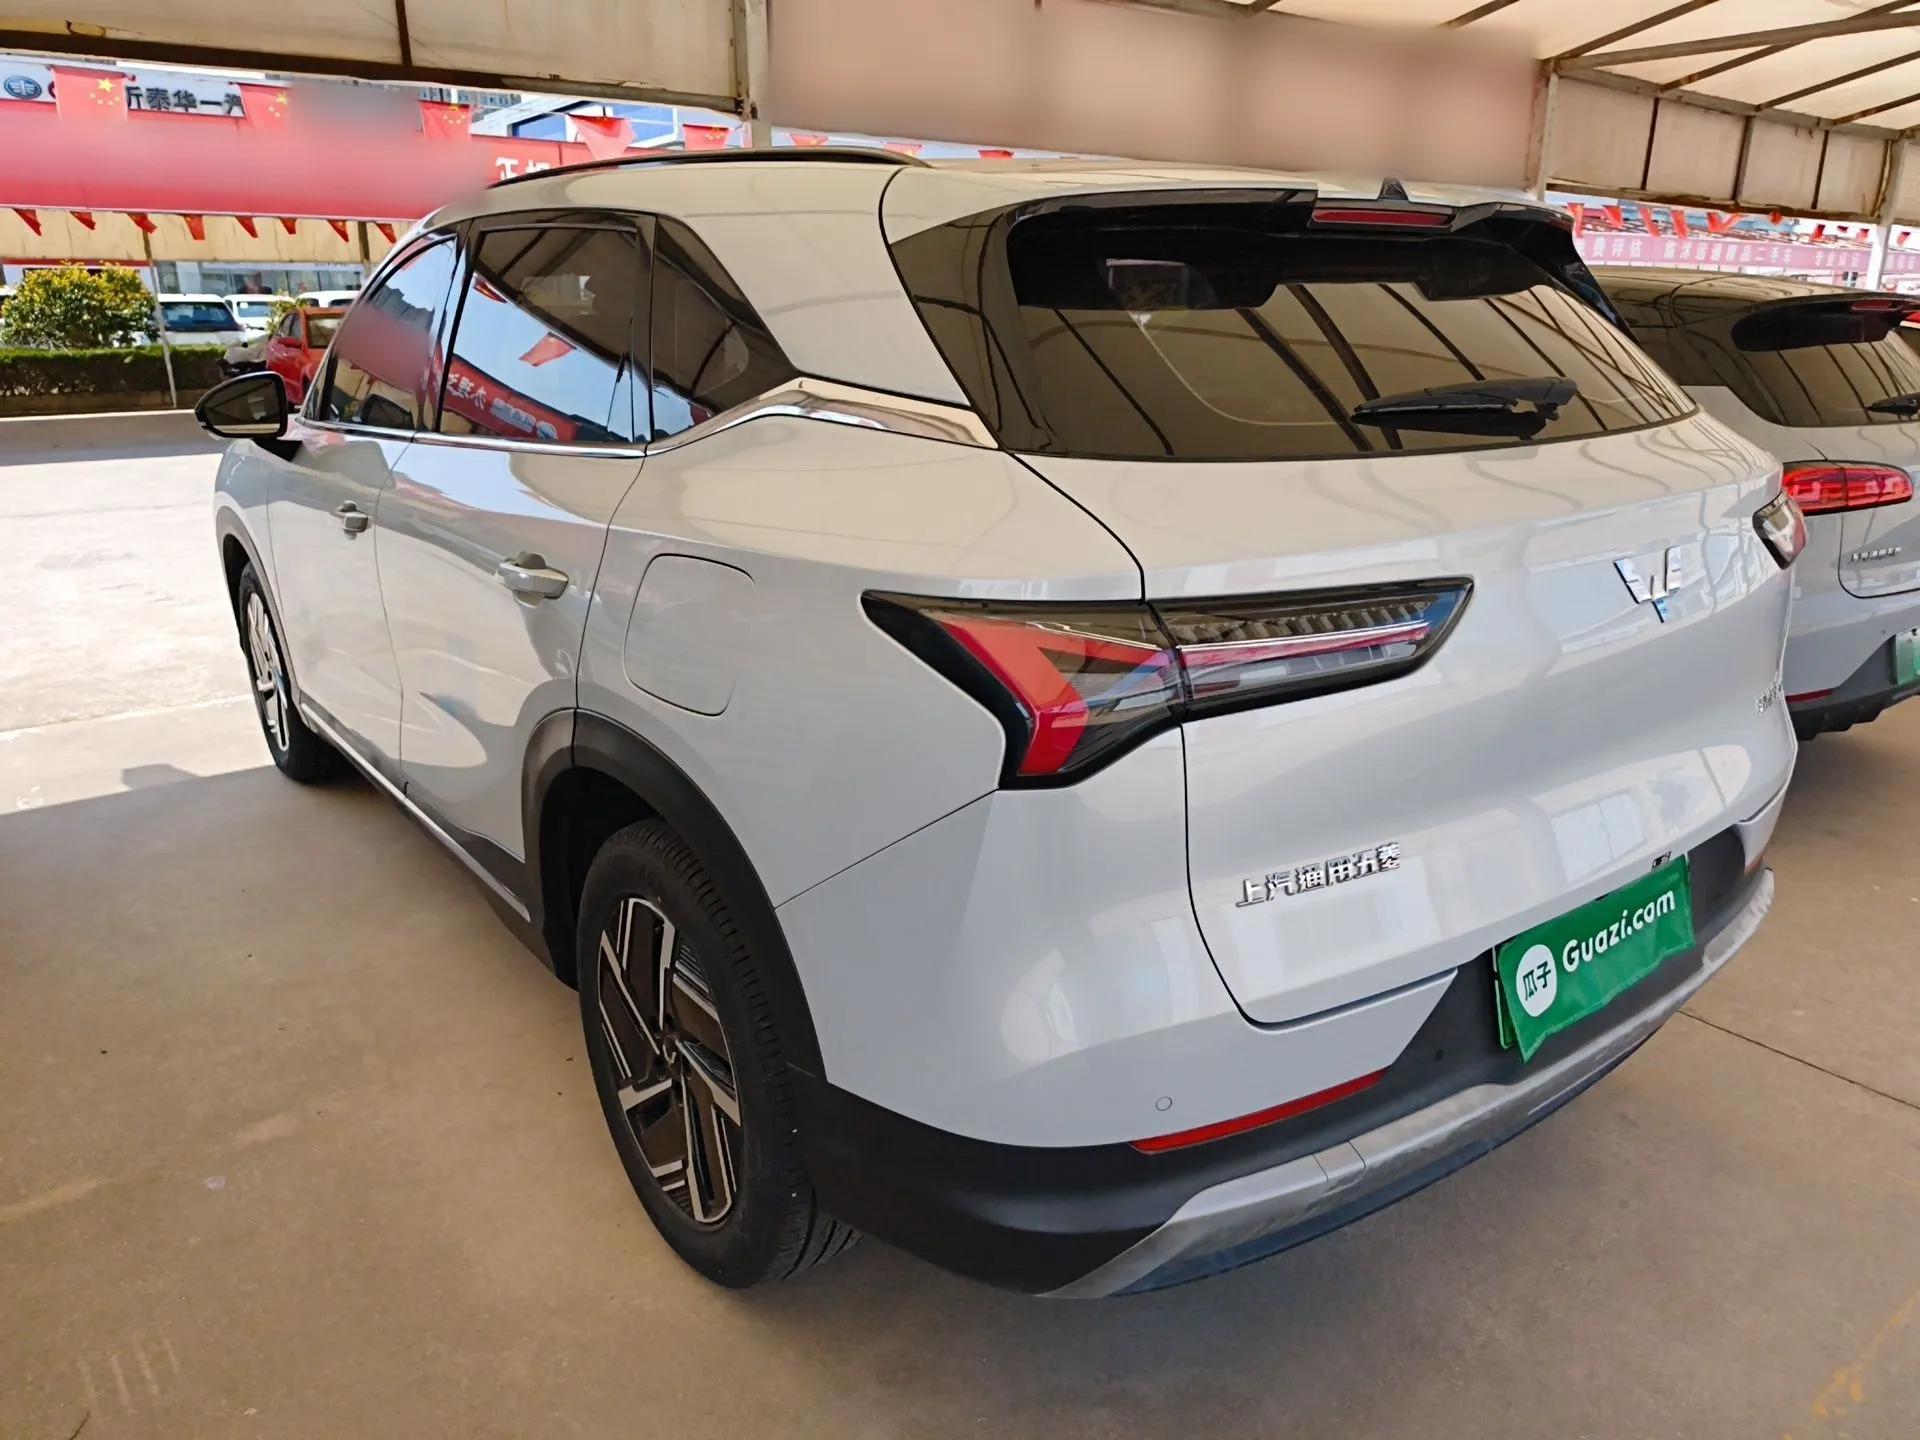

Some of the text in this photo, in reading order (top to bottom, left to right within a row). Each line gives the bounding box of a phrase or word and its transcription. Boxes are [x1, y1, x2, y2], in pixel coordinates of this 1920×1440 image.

[1236, 842, 1400, 908] 上汽通用五菱
[1562, 890, 1676, 973] Guazi.com
[1523, 961, 1551, 1001] 瓜子
